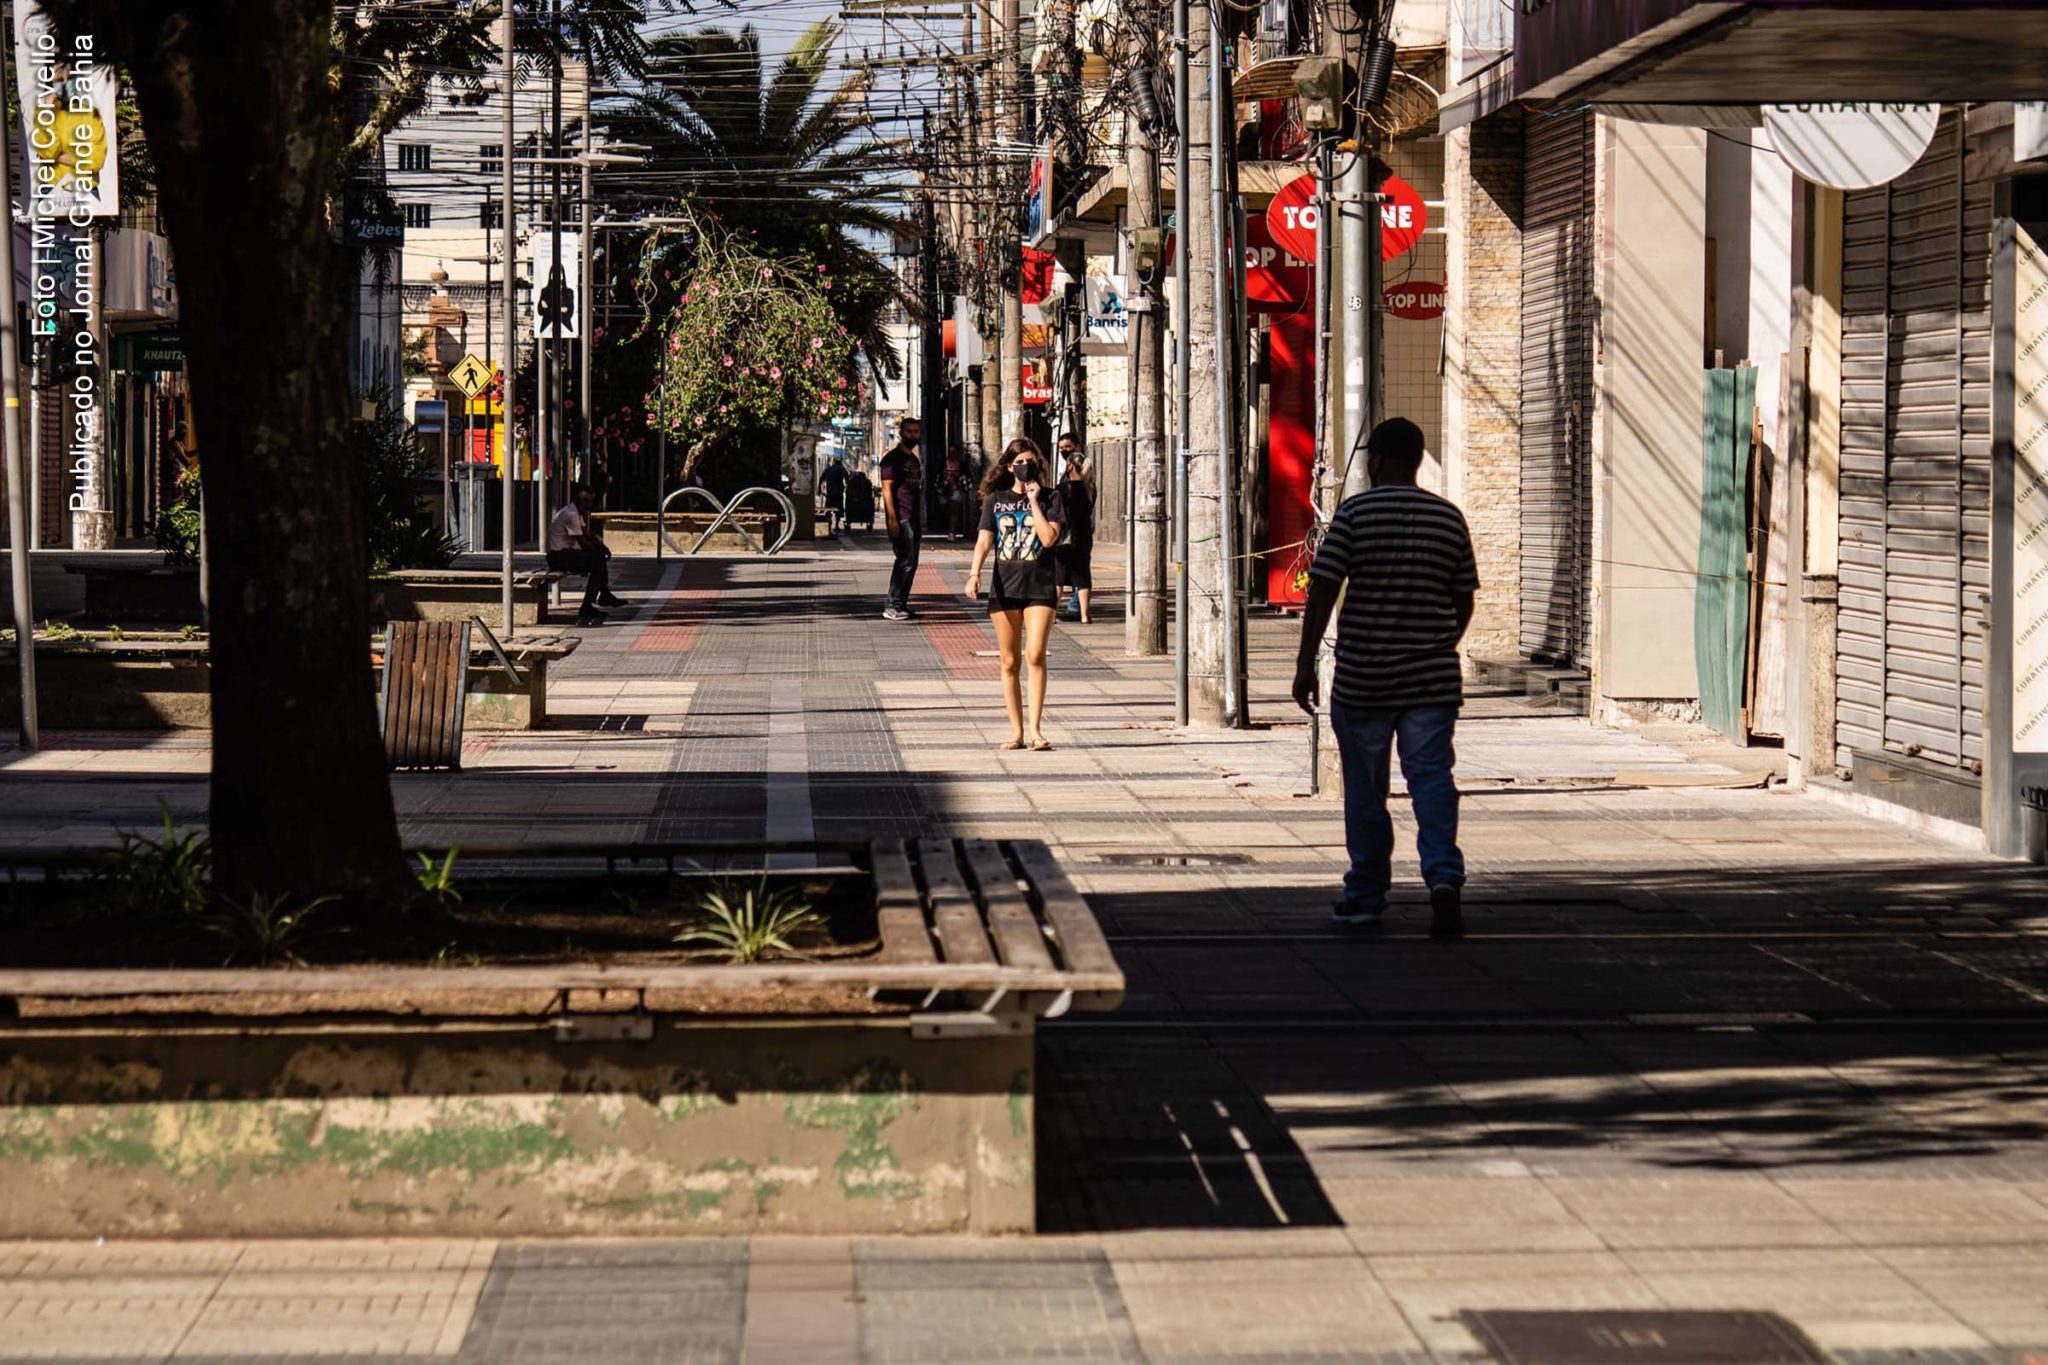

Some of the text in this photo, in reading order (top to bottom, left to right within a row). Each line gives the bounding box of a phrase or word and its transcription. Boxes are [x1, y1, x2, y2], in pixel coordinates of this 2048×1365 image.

[1283, 205, 1317, 230] TO
[1386, 293, 1444, 309] TOP LIN
[1087, 315, 1129, 328] Banris
[993, 502, 1016, 513] PINK
